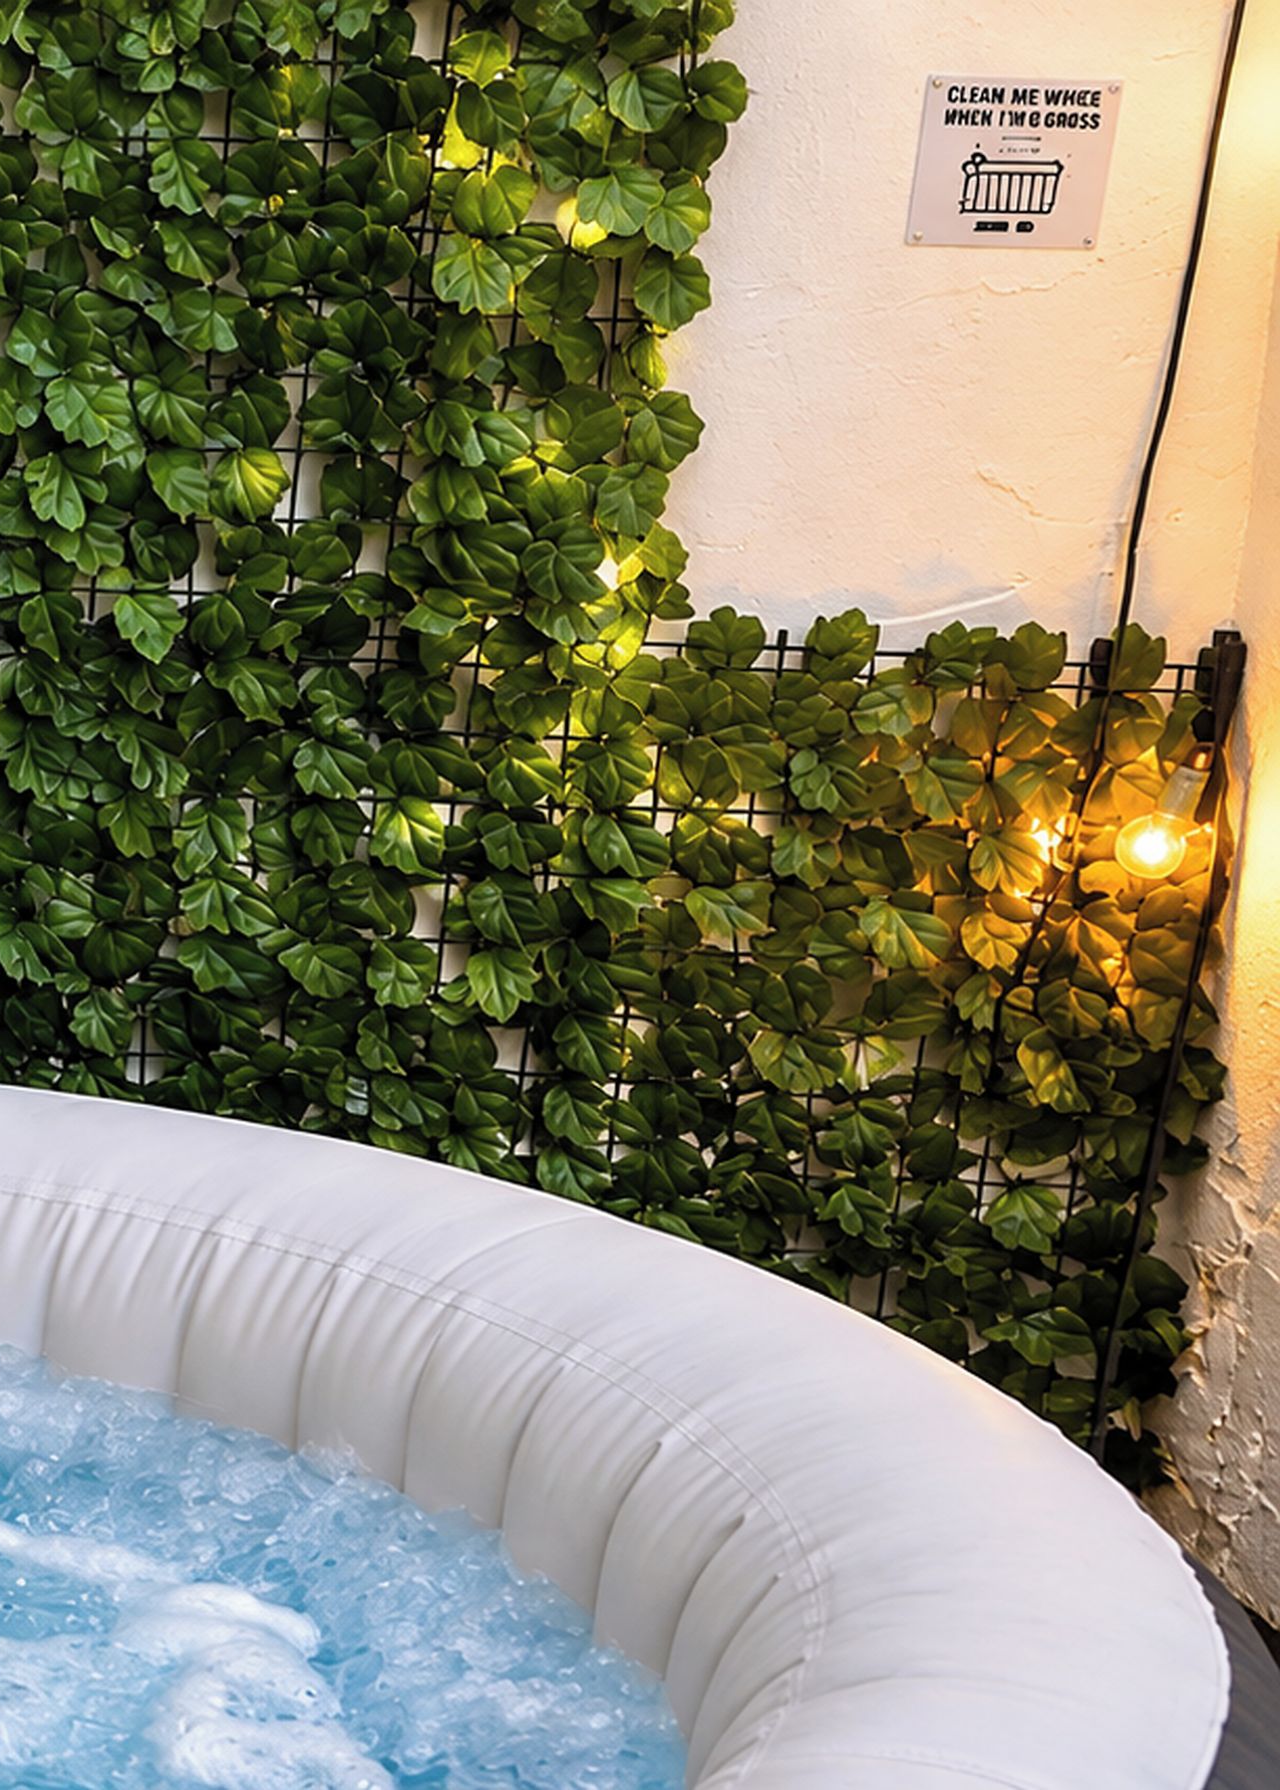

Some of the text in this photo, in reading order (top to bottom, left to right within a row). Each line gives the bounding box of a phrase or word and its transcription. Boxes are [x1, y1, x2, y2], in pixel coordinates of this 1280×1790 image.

[947, 85, 1005, 105] CLEAN
[1010, 88, 1040, 106] ME
[944, 108, 993, 127] WHEN
